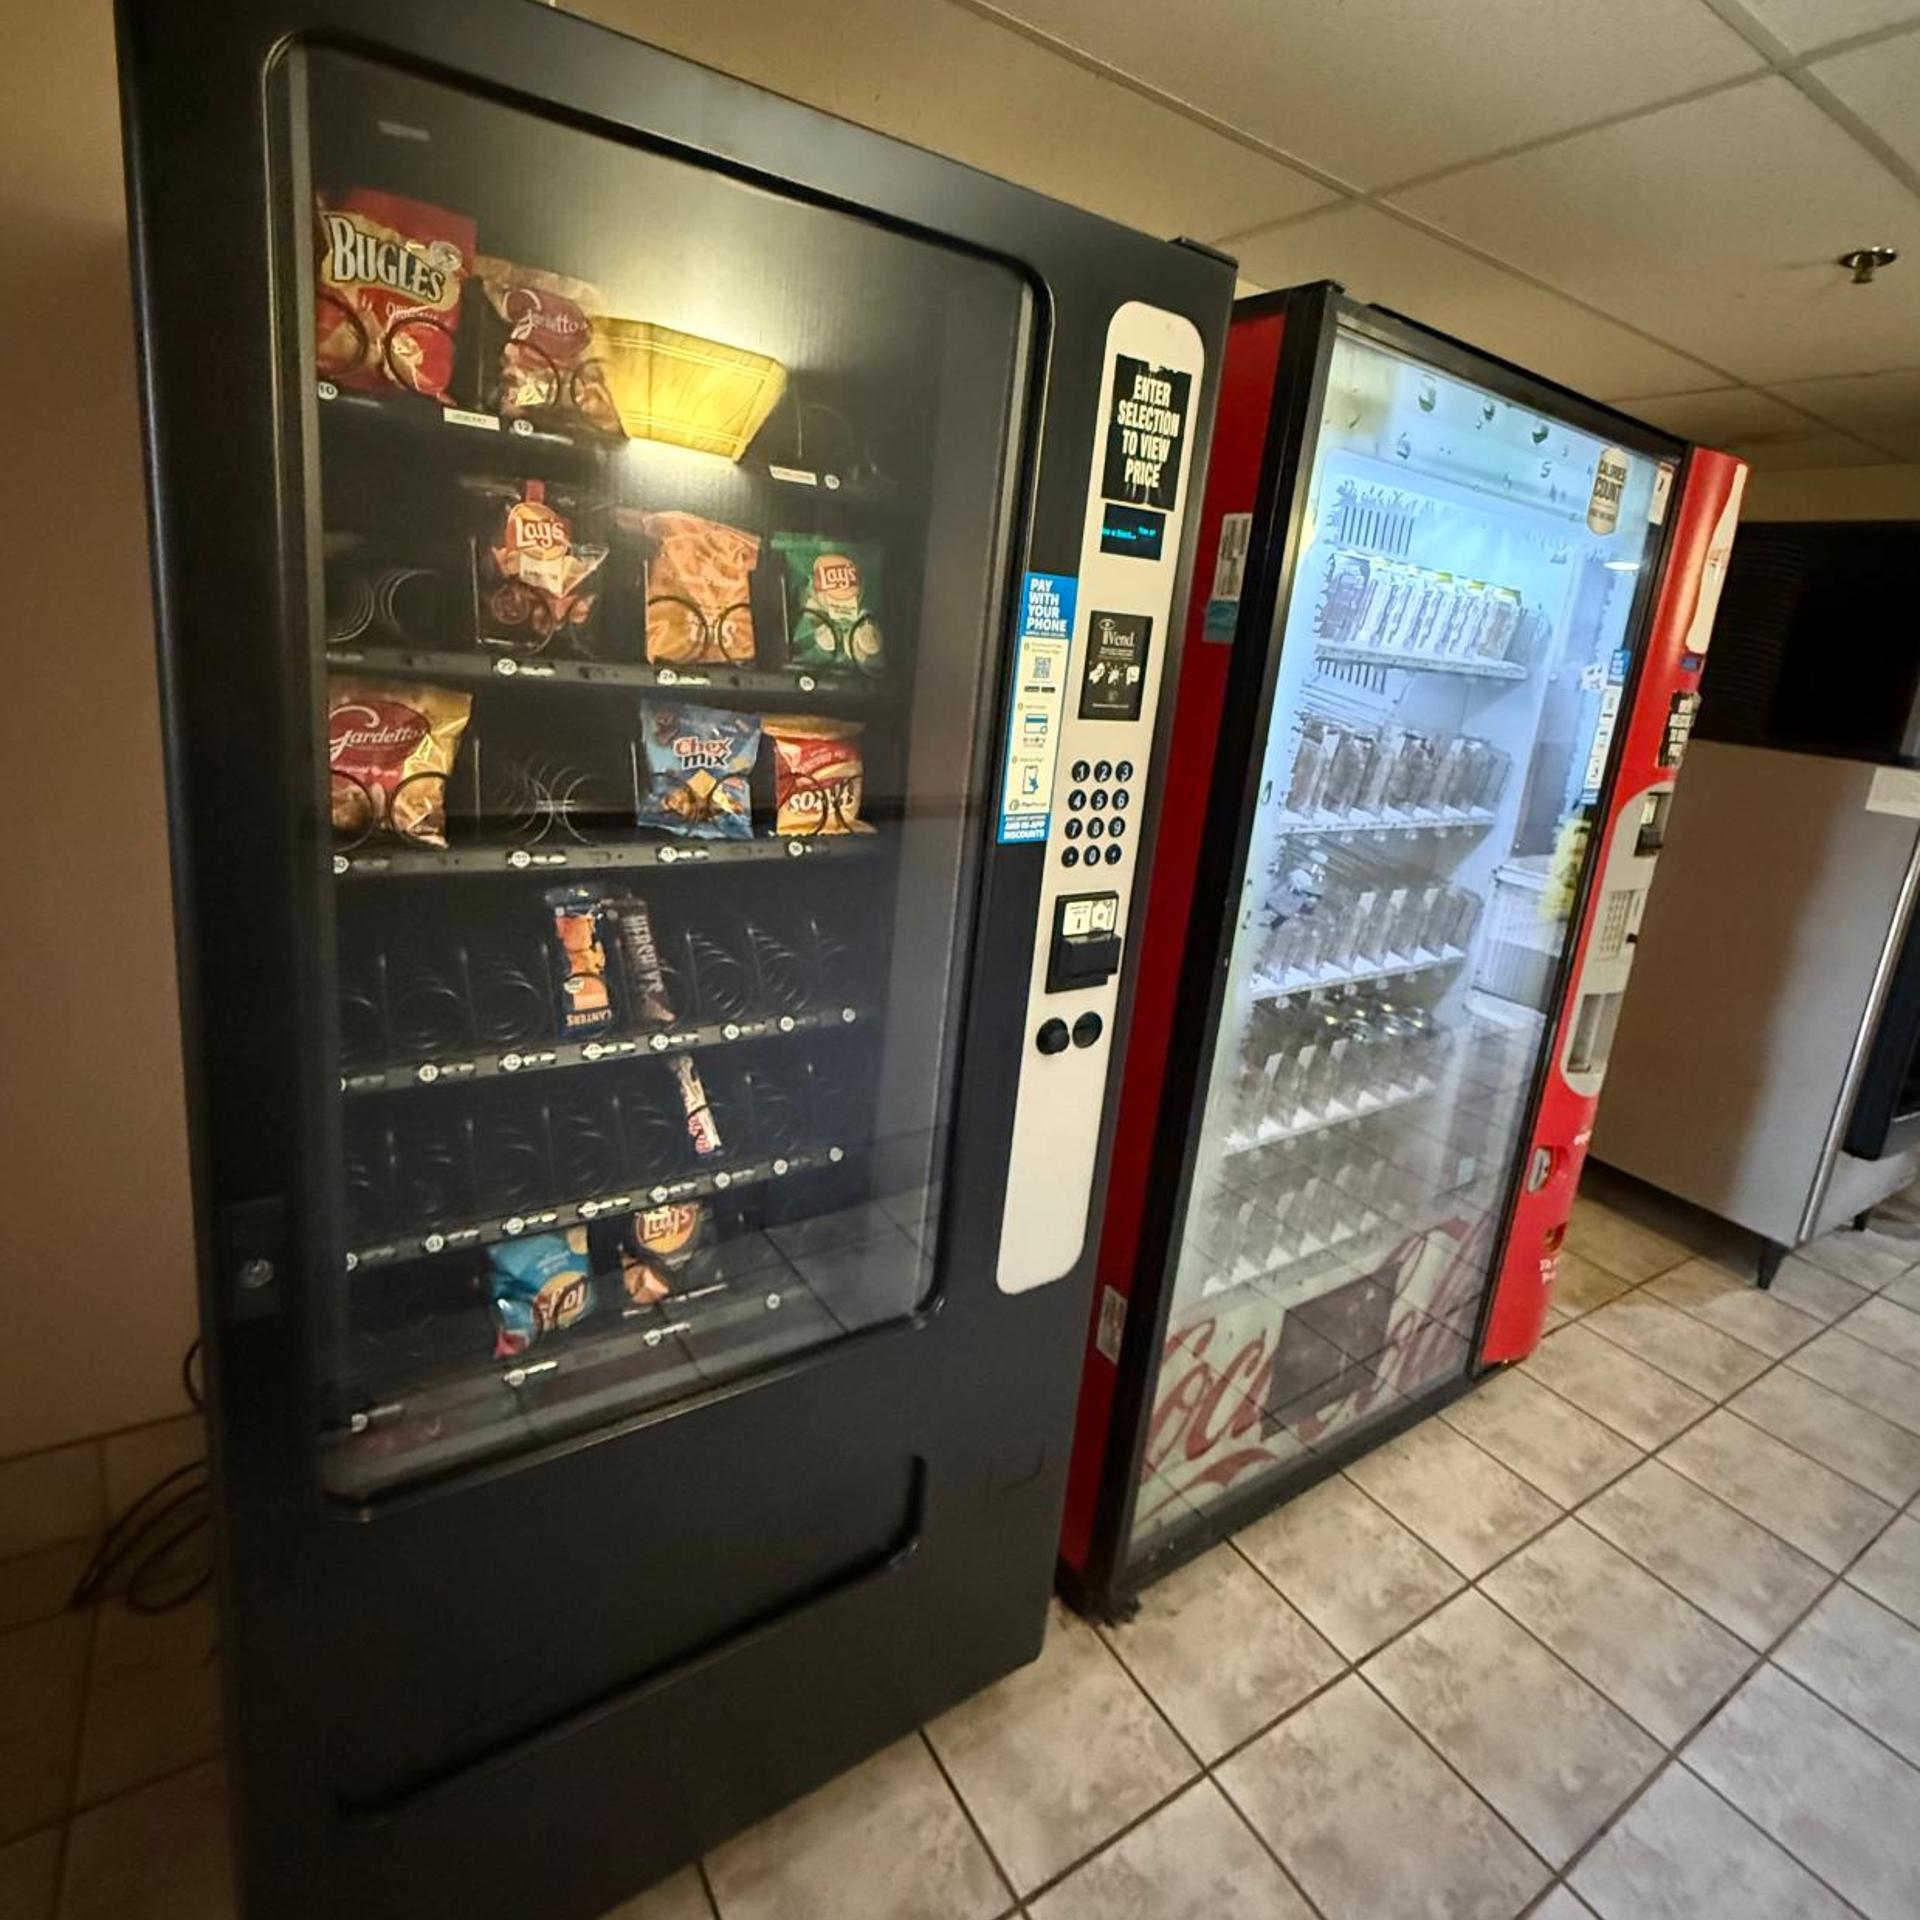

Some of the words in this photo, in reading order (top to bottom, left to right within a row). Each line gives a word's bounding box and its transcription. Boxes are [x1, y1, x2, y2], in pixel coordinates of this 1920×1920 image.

[326, 214, 445, 303] BUGLES
[1133, 374, 1172, 408] ENTER
[1117, 399, 1181, 438] SELECTION
[1122, 428, 1139, 456] TO
[1140, 432, 1171, 463] VIEW
[1124, 458, 1162, 489] PRICE
[515, 515, 566, 549] Lay's
[818, 563, 857, 591] Lay's
[1030, 577, 1053, 593] PAY
[1028, 590, 1060, 606] WITH
[1028, 604, 1060, 619] YOUR
[1026, 616, 1068, 633] PHONE
[674, 736, 734, 757] Chex
[1073, 793, 1082, 808] 4
[1096, 793, 1104, 808] 5
[1117, 792, 1126, 808] 6
[1071, 821, 1079, 836] 7
[1092, 821, 1101, 836] 8
[1113, 820, 1122, 835] 9
[1088, 848, 1097, 863] 0
[565, 1009, 614, 1027] LANTERS
